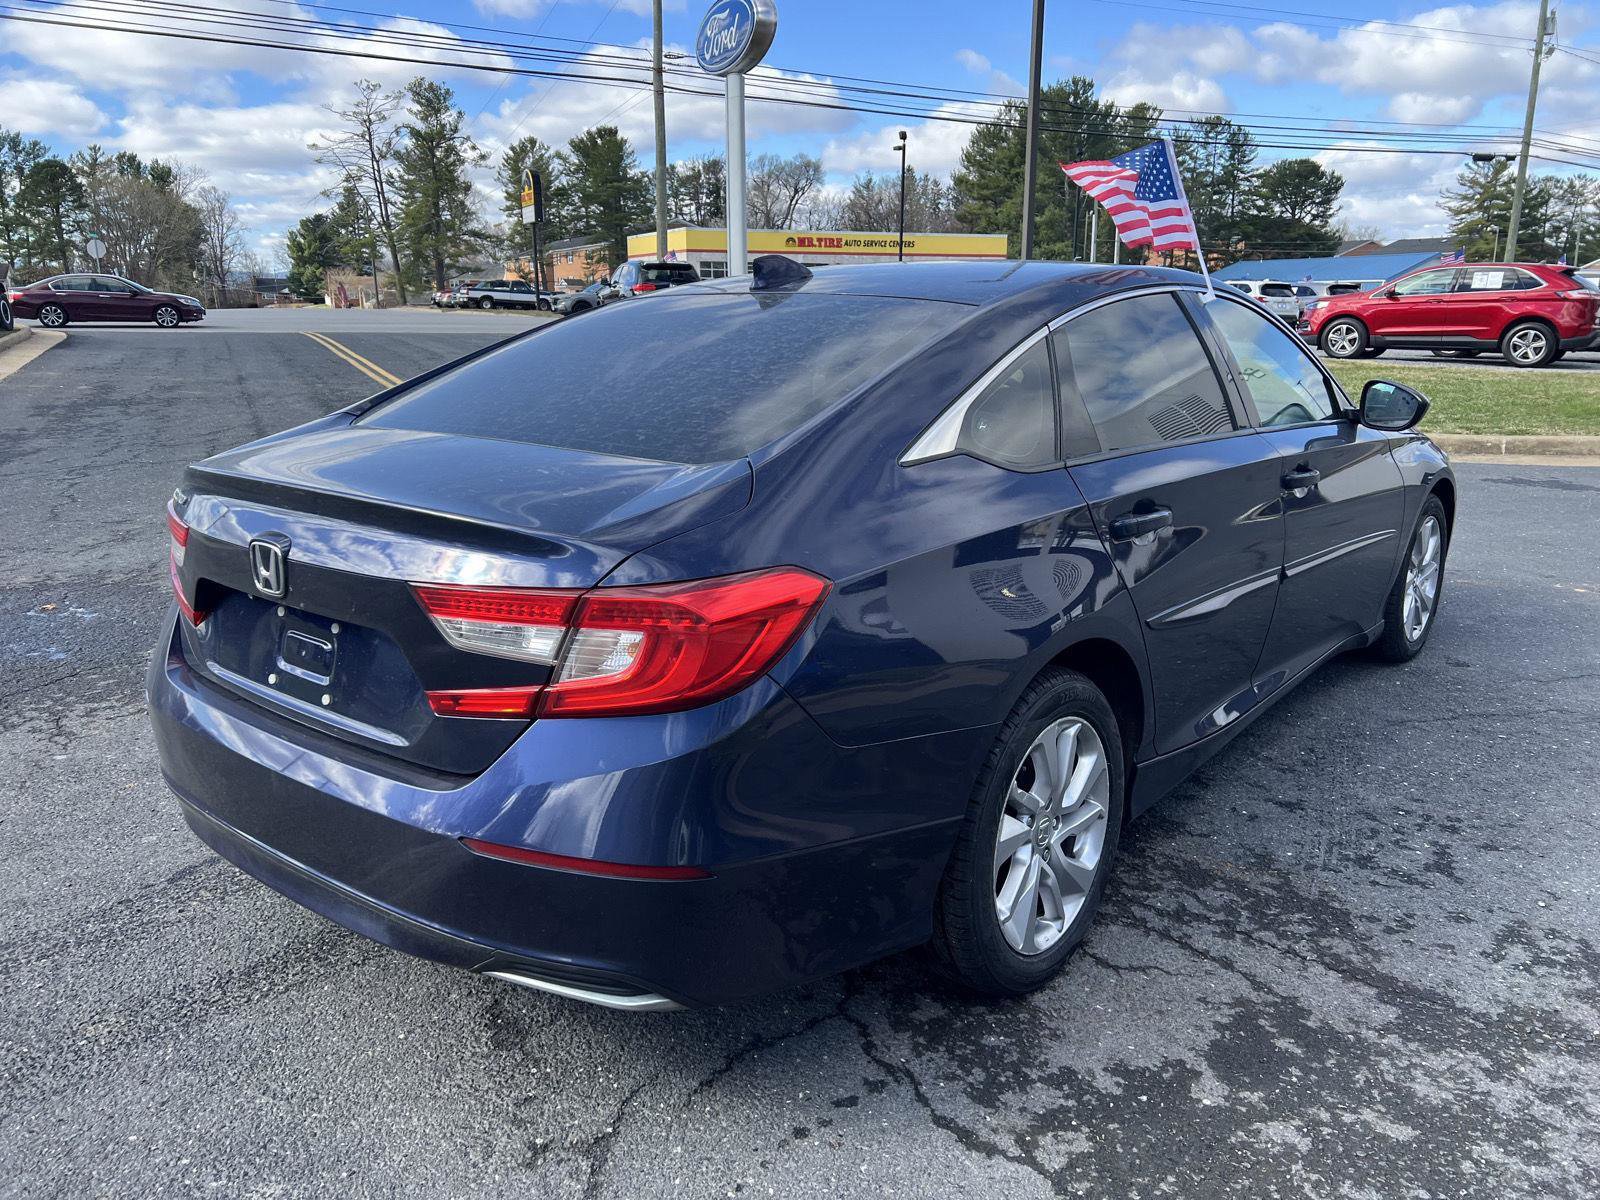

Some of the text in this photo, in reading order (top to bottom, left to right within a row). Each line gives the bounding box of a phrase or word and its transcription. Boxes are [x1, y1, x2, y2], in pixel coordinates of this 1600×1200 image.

[704, 8, 740, 61] Ford
[816, 237, 843, 248] TIRE
[862, 240, 887, 248] SERVICE
